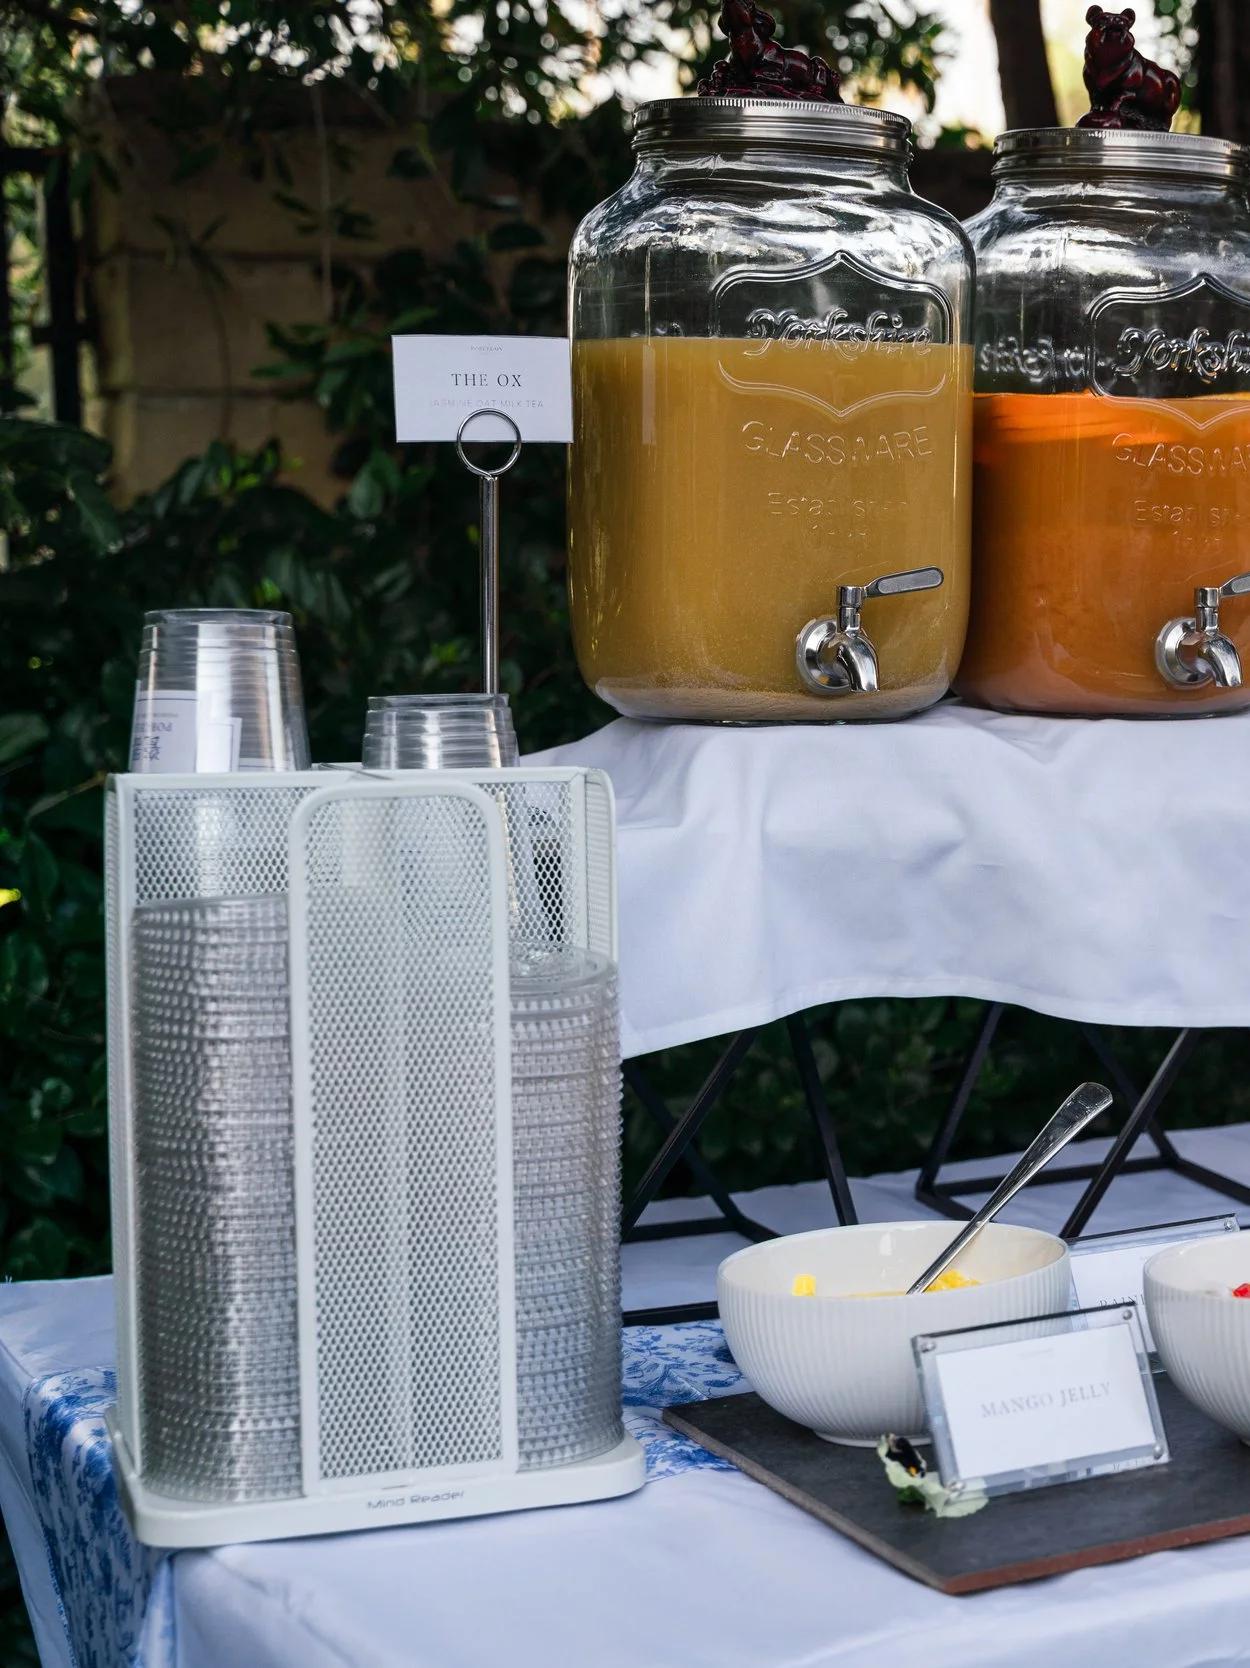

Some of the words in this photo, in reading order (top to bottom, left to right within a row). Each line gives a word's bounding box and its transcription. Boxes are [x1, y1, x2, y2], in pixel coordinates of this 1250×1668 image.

[451, 373, 488, 387] THE
[497, 374, 522, 387] OX
[476, 400, 496, 408] OAT
[526, 400, 544, 408] TEA
[981, 1391, 1054, 1418] MANGO
[1060, 1382, 1111, 1407] JELLY
[367, 1498, 405, 1509] Mind
[410, 1491, 465, 1503] Reader
